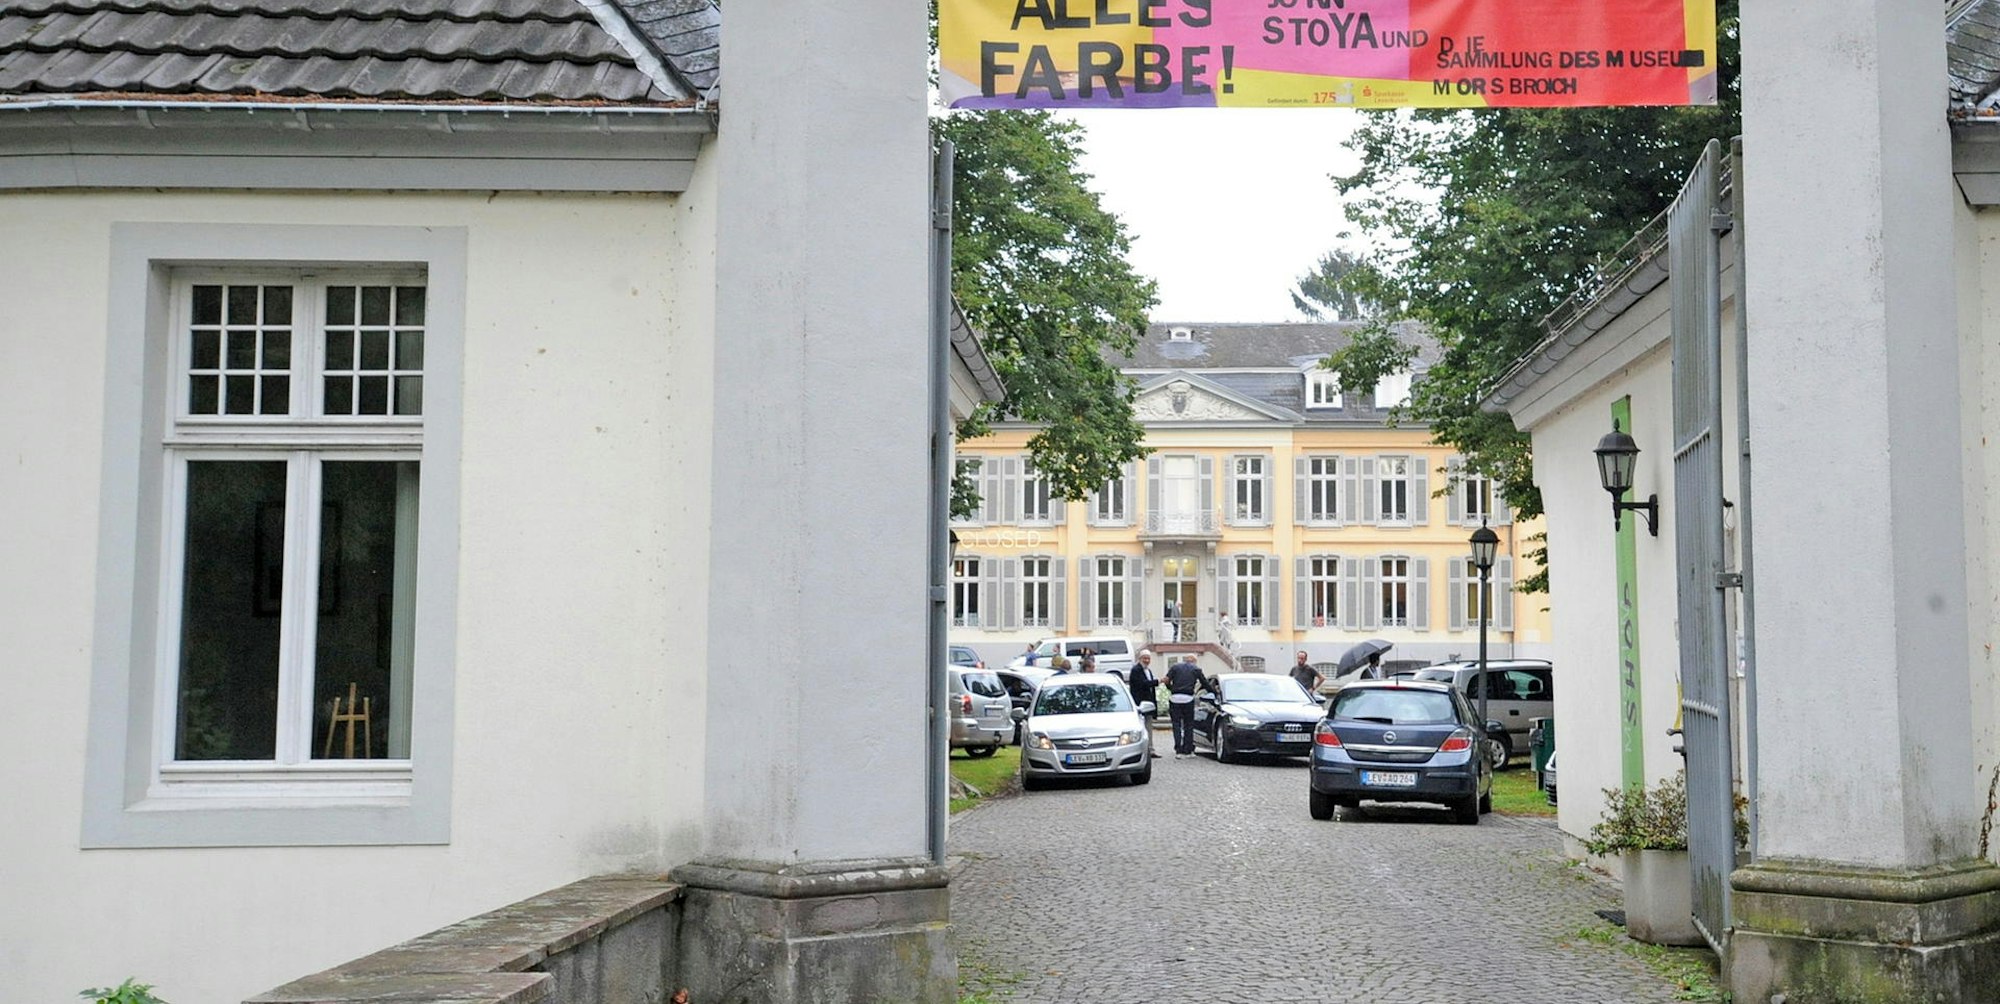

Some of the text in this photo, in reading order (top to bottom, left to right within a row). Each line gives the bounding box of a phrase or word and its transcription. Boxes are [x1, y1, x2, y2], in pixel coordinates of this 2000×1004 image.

[1382, 29, 1429, 48] UND
[1436, 50, 1705, 69] SAMMLUNG DES MUSEU
[981, 40, 1235, 100] FARBE!
[1509, 77, 1577, 94] BROICH
[1313, 92, 1336, 104] 175
[960, 530, 1041, 549] CLOSED
